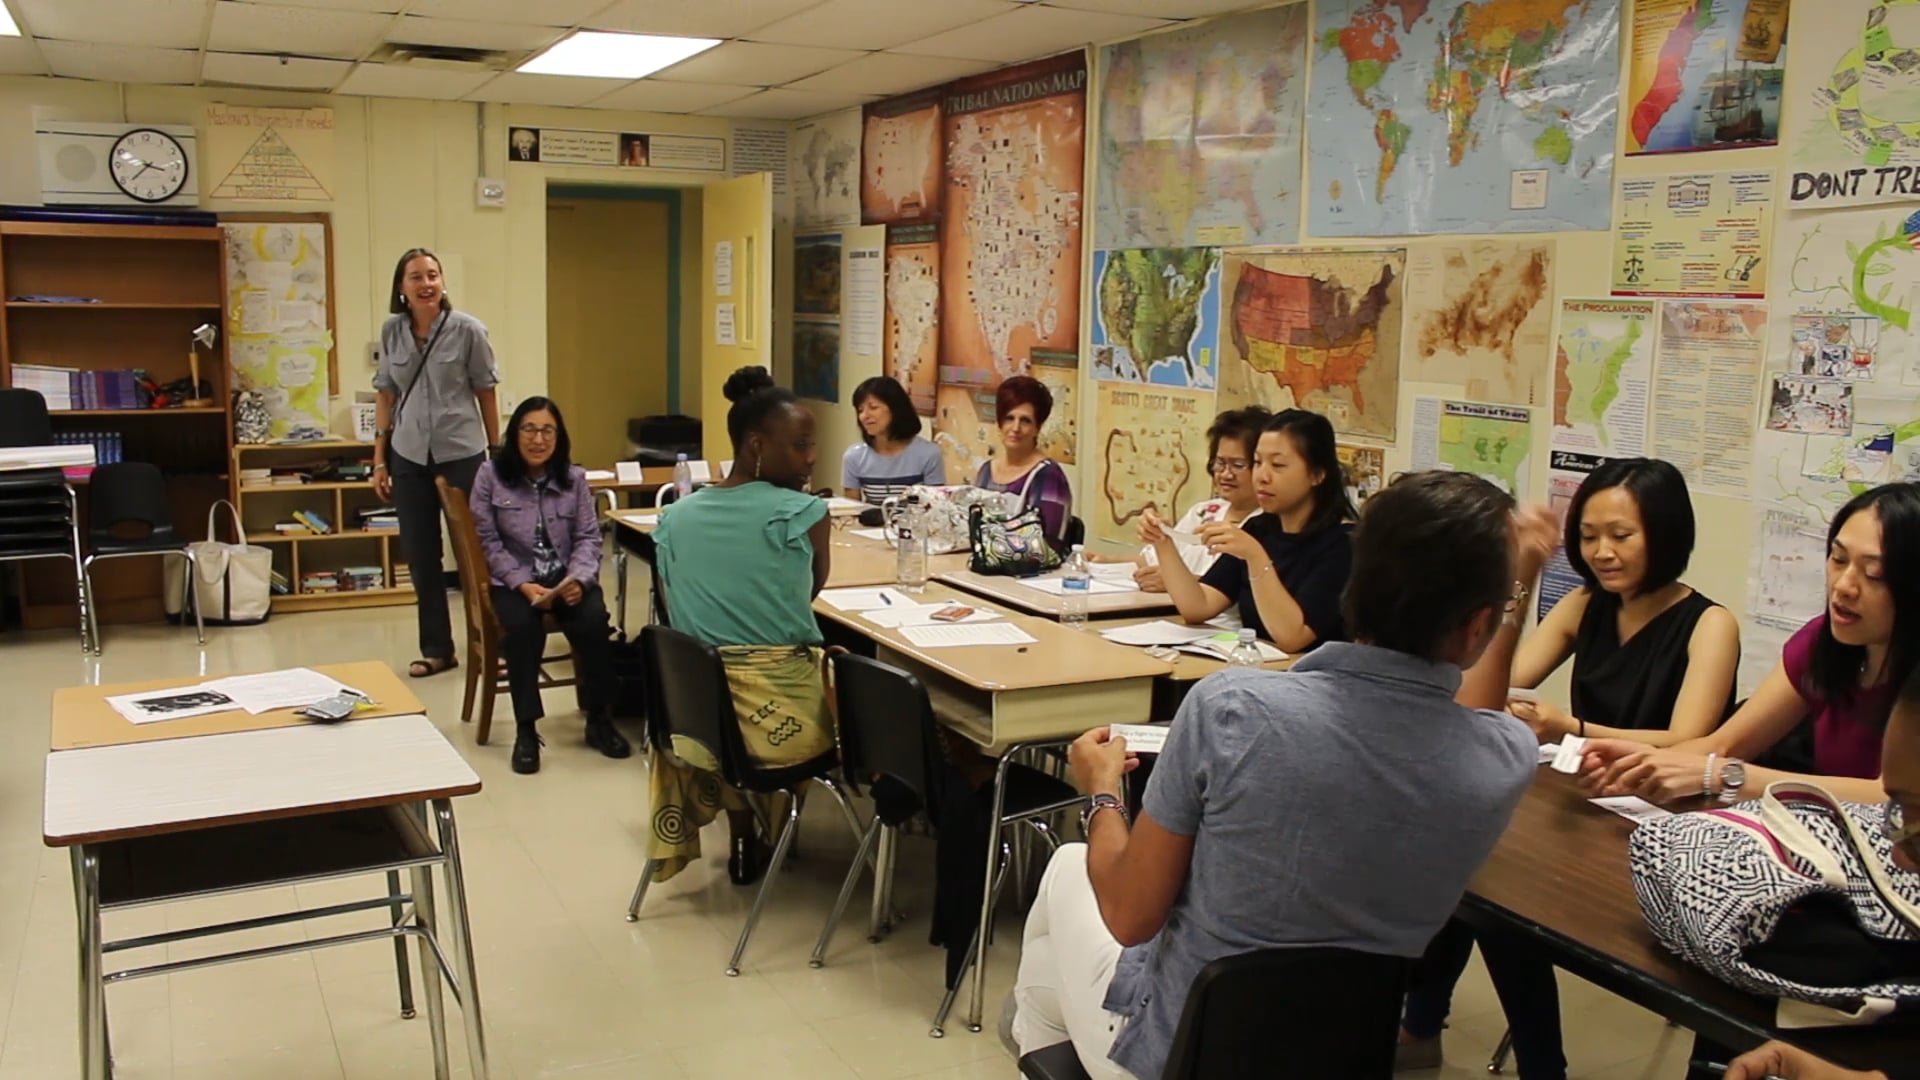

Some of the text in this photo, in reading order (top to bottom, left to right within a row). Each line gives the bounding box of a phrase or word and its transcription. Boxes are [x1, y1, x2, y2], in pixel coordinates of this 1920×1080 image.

[948, 70, 1085, 114] TRIBAL NATIONS MAP
[1791, 168, 1867, 201] DONT
[1563, 303, 1653, 313] THE PROCLAMATION
[1446, 403, 1461, 411] The
[1463, 405, 1486, 415] Trail
[1500, 409, 1527, 419] Tears
